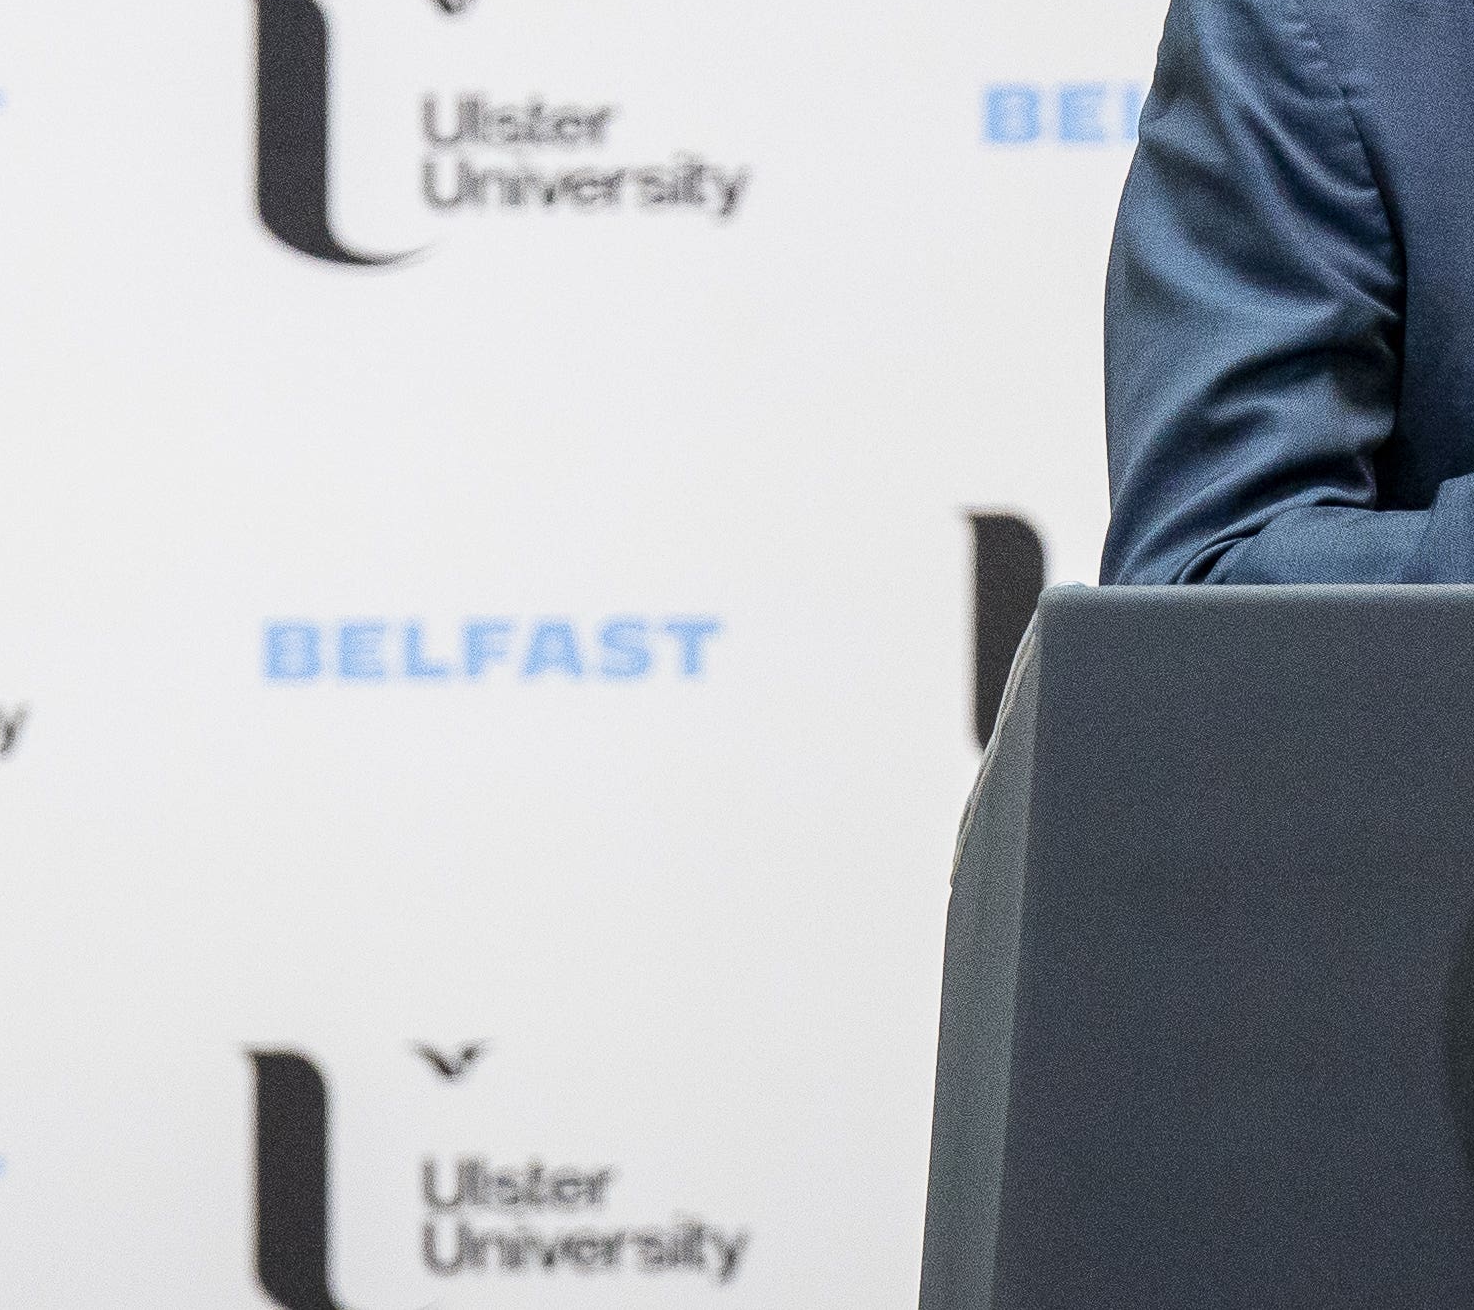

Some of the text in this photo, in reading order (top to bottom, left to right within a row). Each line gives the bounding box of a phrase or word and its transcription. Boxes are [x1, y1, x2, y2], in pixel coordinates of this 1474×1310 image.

[420, 93, 613, 149] Ulster
[420, 158, 747, 219] University
[260, 614, 722, 684] BELFAST
[419, 1157, 613, 1215] Ulster
[419, 1220, 748, 1283] University
